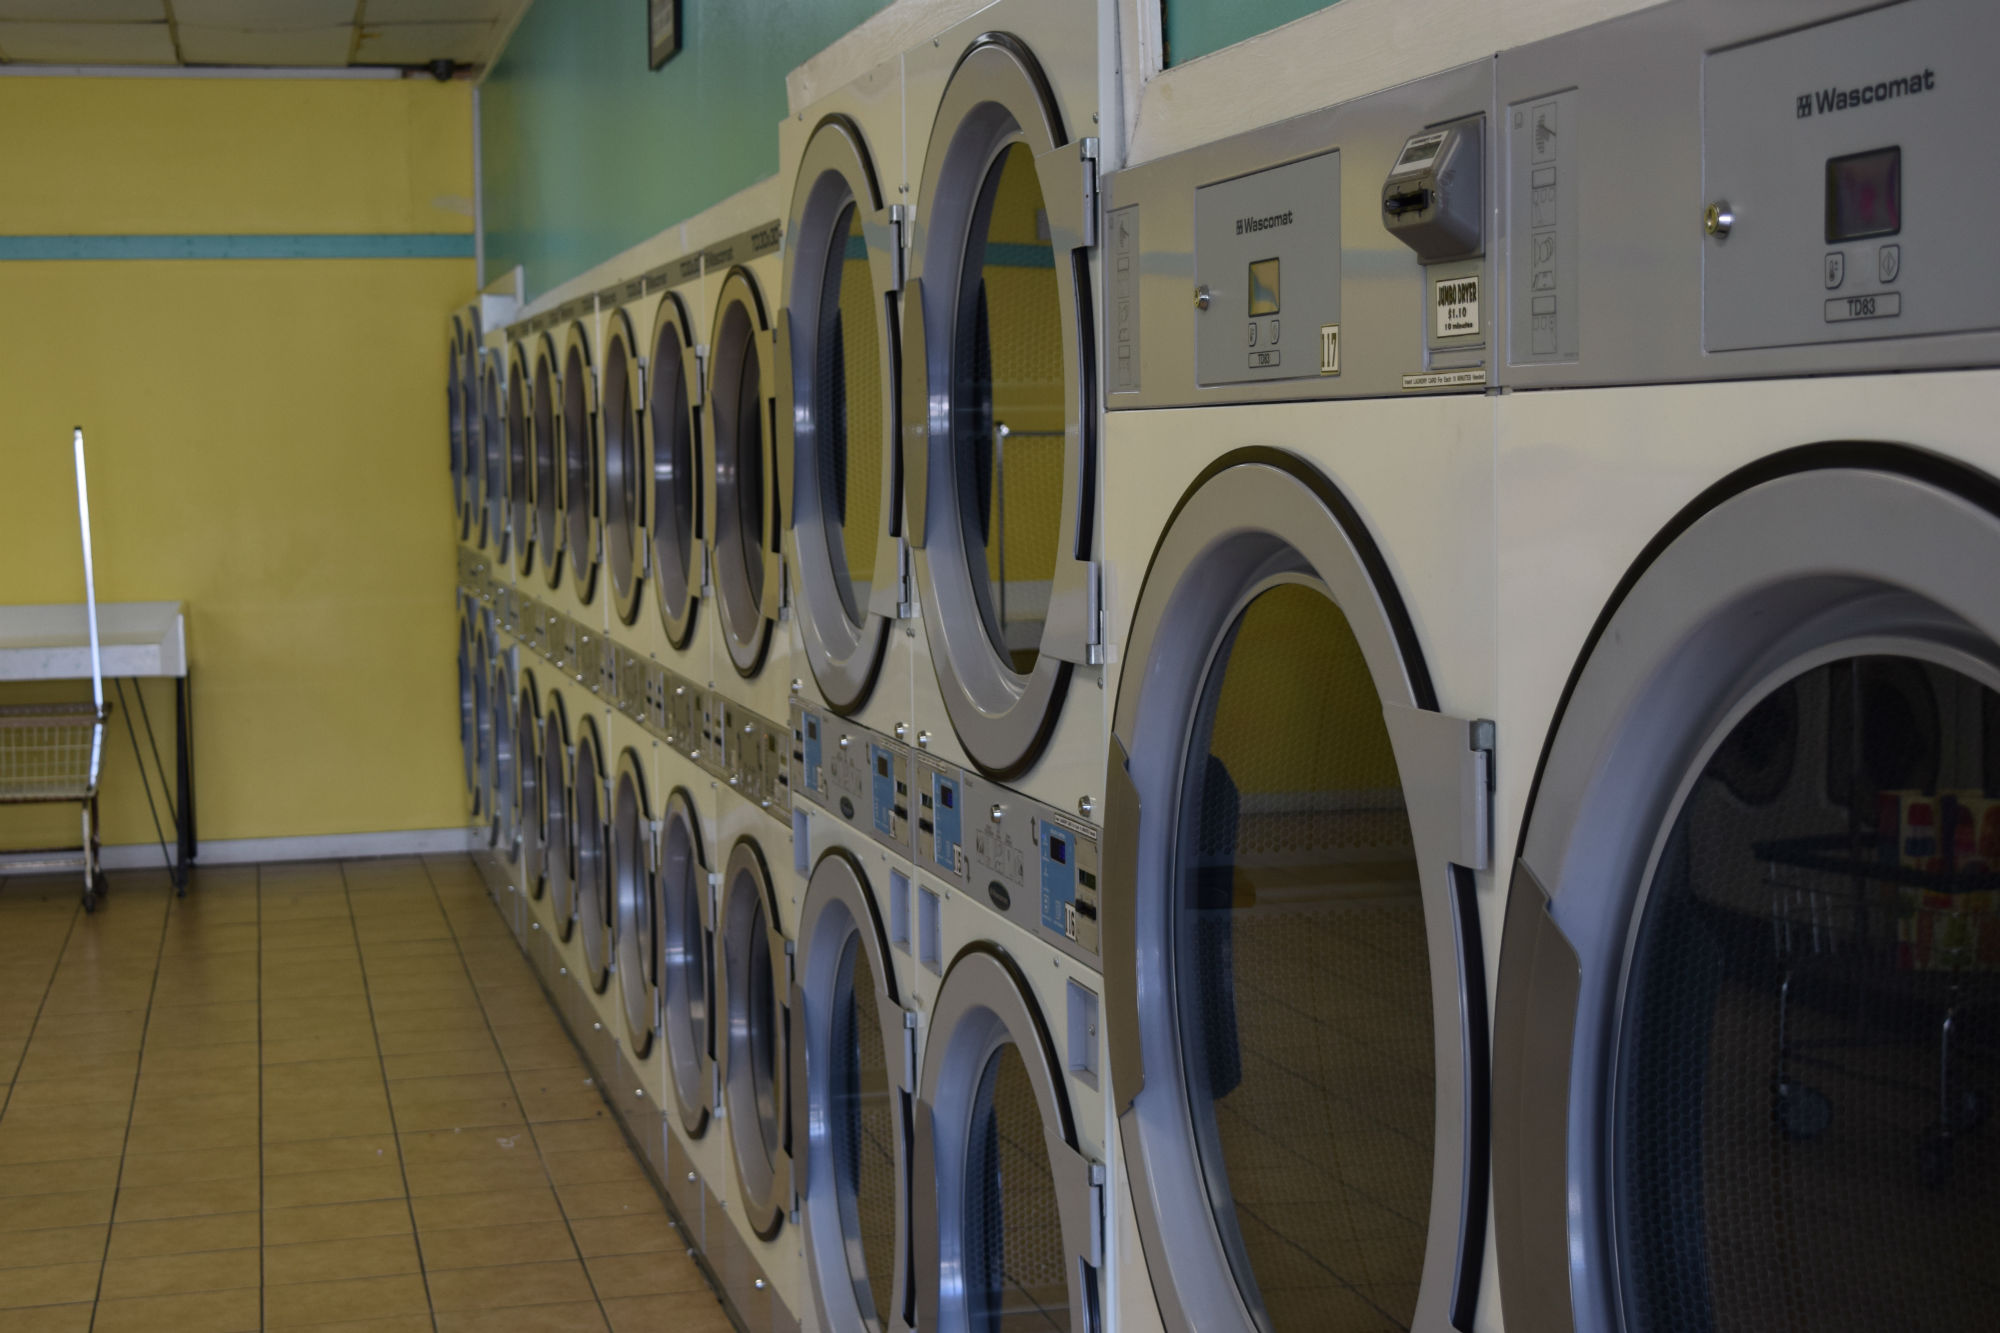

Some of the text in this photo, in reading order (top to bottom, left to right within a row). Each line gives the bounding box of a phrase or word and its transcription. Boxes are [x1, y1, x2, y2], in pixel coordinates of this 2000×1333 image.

[1815, 68, 1935, 114] Wascomat
[1244, 210, 1293, 234] Wascomat
[1438, 282, 1477, 306] JUMBO DRYER
[1448, 307, 1467, 320] $1.10
[1847, 298, 1876, 316] TD83
[1321, 332, 1337, 368] 117
